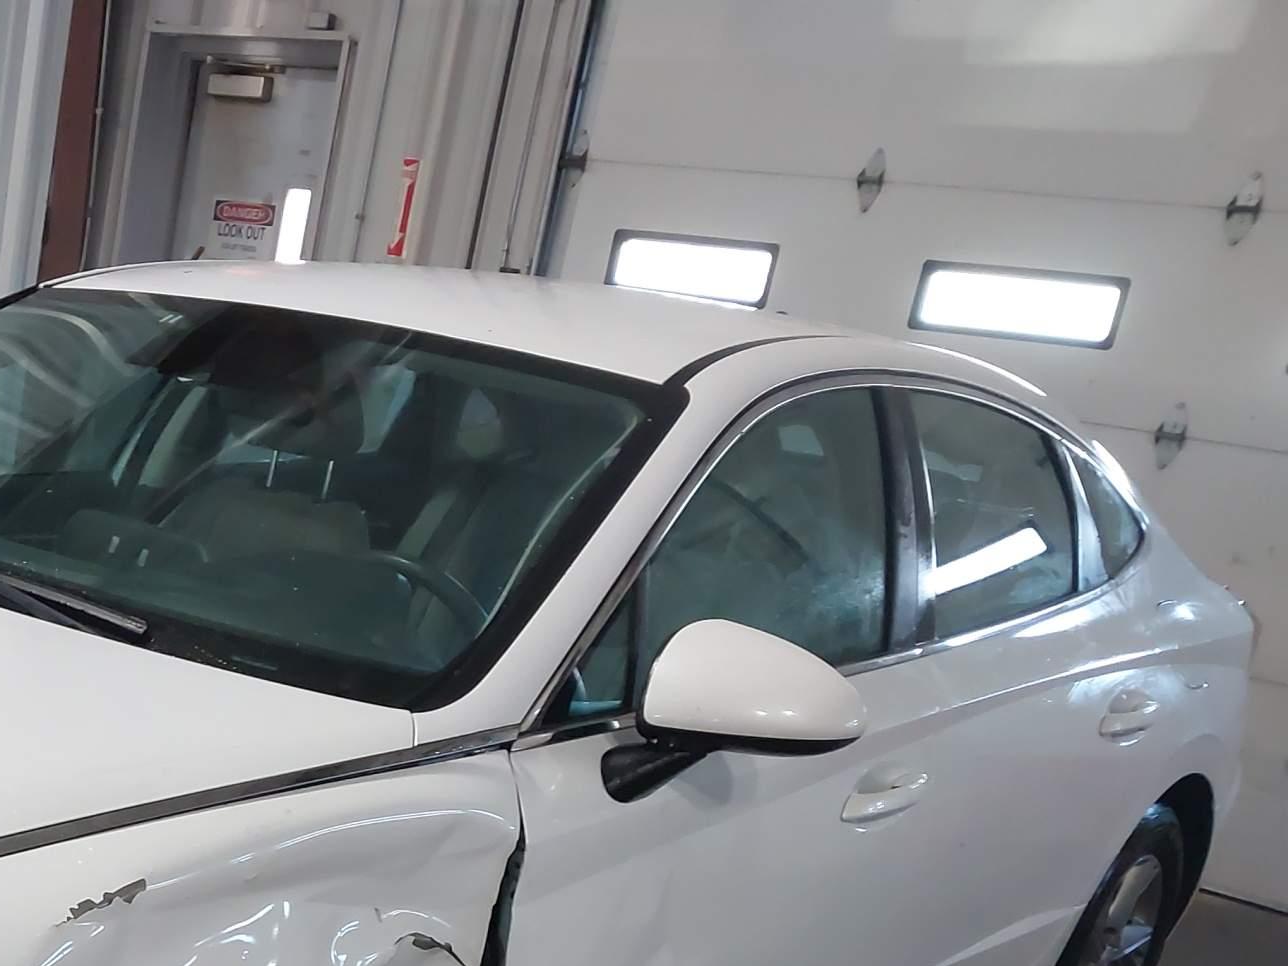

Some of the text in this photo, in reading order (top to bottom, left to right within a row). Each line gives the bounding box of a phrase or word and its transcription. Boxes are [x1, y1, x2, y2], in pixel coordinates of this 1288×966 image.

[222, 205, 266, 220] DANGER
[217, 223, 267, 240] LOOK OUT
